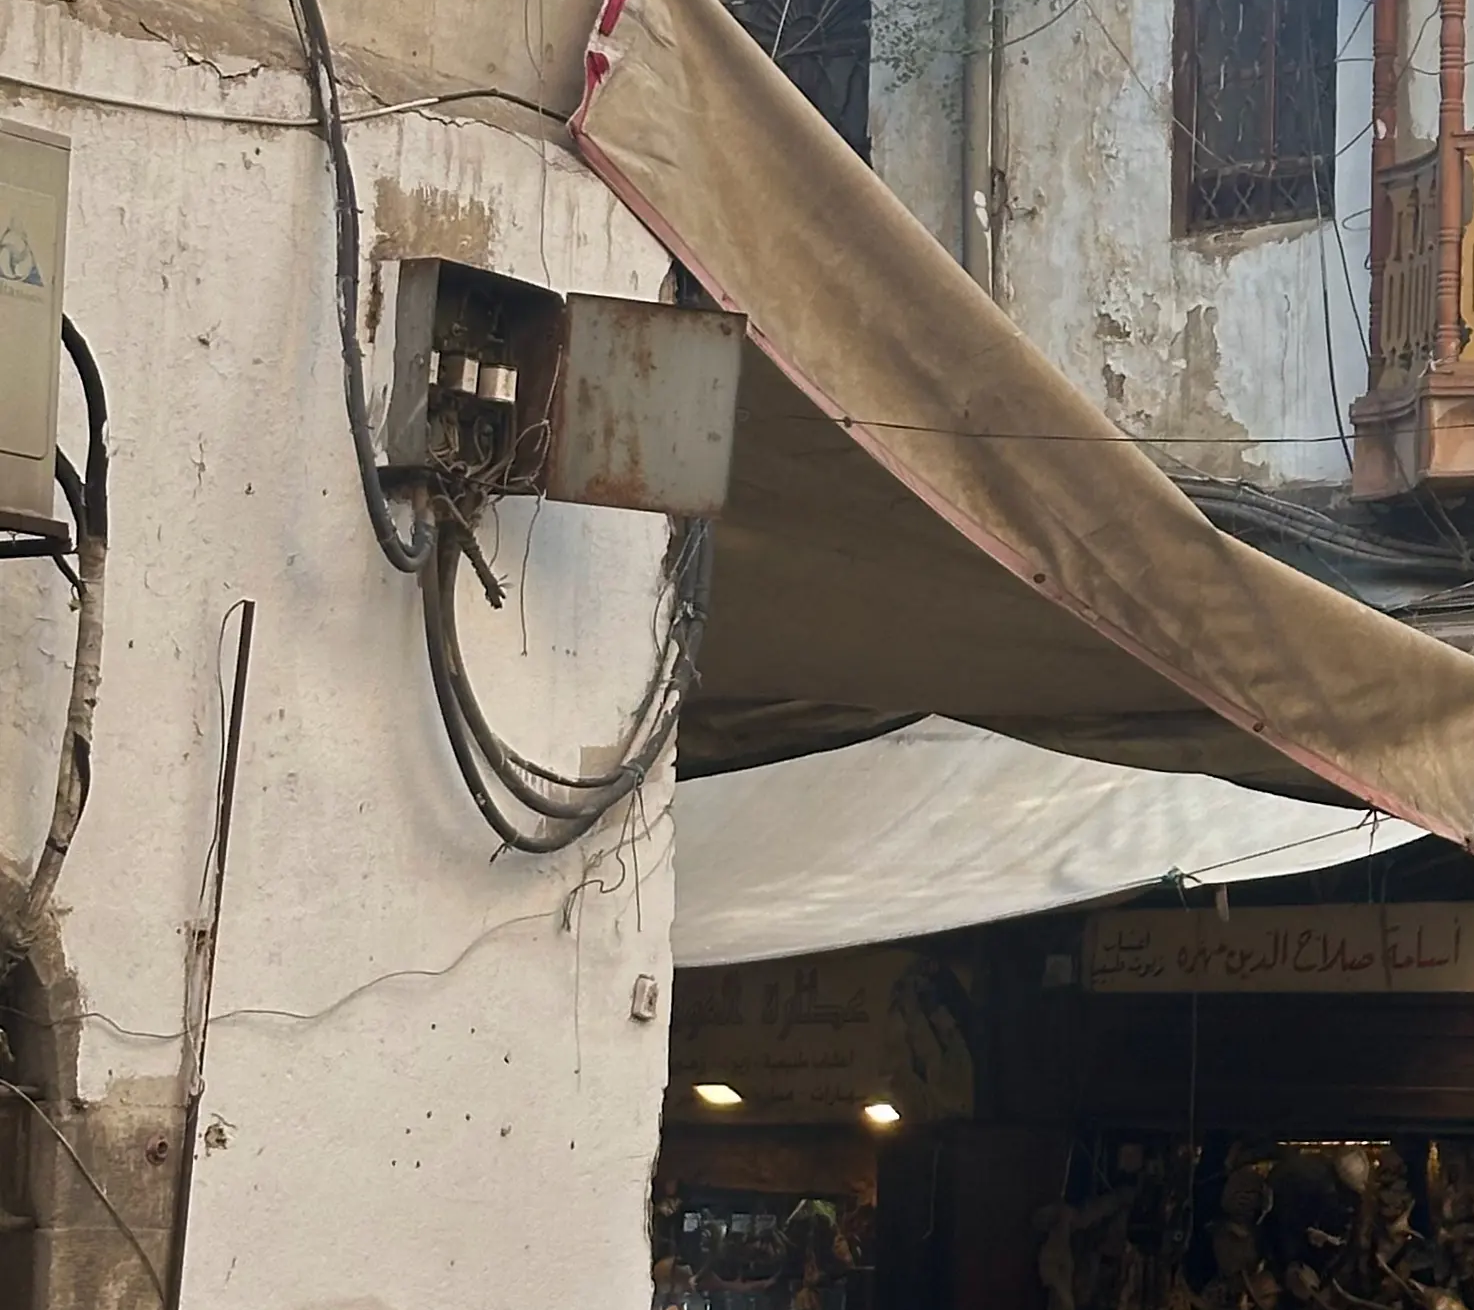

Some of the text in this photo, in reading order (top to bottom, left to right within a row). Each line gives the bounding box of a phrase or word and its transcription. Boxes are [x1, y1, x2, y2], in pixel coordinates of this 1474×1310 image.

[1225, 927, 1288, 981] الدين
[1293, 927, 1375, 973] صلاح
[1385, 915, 1461, 969] أسامة
